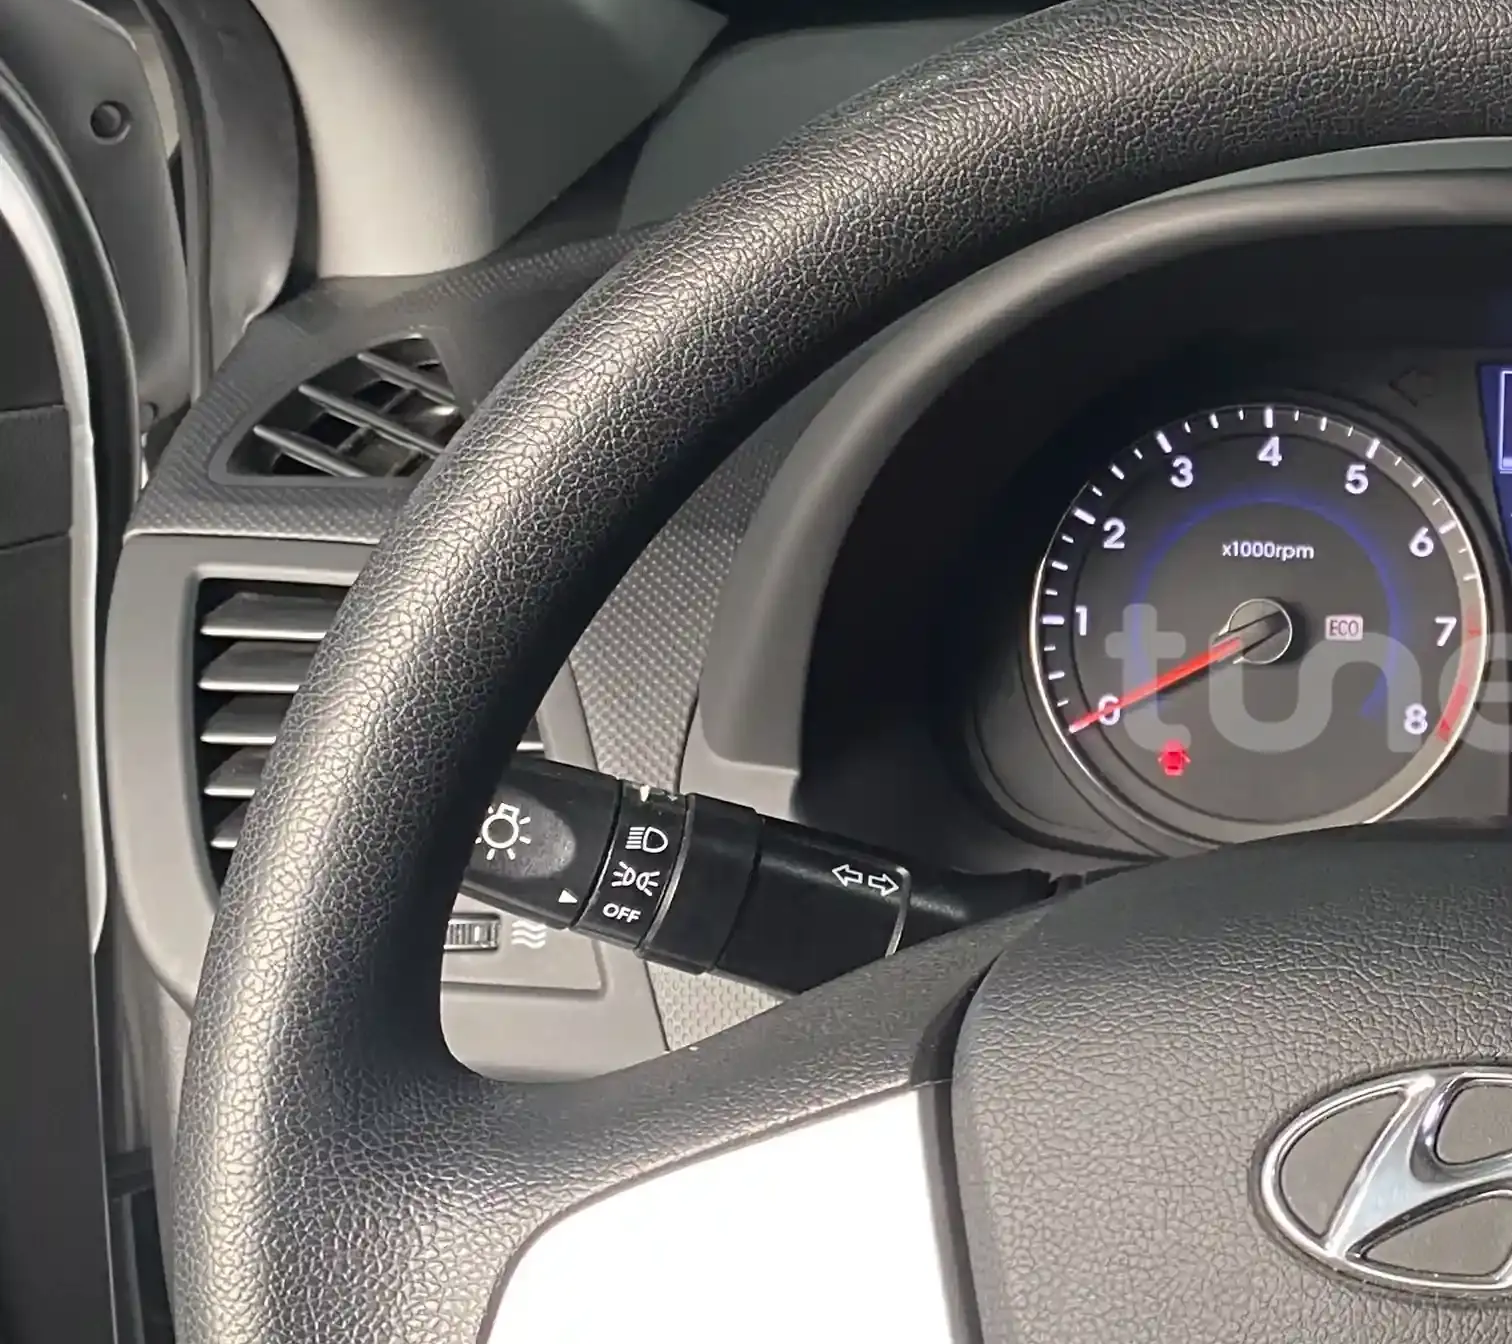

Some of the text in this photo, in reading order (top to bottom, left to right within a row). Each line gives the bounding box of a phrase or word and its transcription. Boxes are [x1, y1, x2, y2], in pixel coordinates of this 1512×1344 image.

[1258, 436, 1282, 467] 4
[1170, 457, 1194, 488] 3
[1345, 464, 1369, 494] 5
[1103, 518, 1126, 549] 2
[1409, 527, 1434, 557] 6
[1221, 541, 1314, 563] x1000rpm
[1075, 605, 1088, 636] 1
[1329, 620, 1358, 636] ECO
[1434, 617, 1457, 647] 7
[1098, 694, 1121, 726] 0
[1403, 704, 1428, 735] 8
[602, 903, 641, 923] OFF
